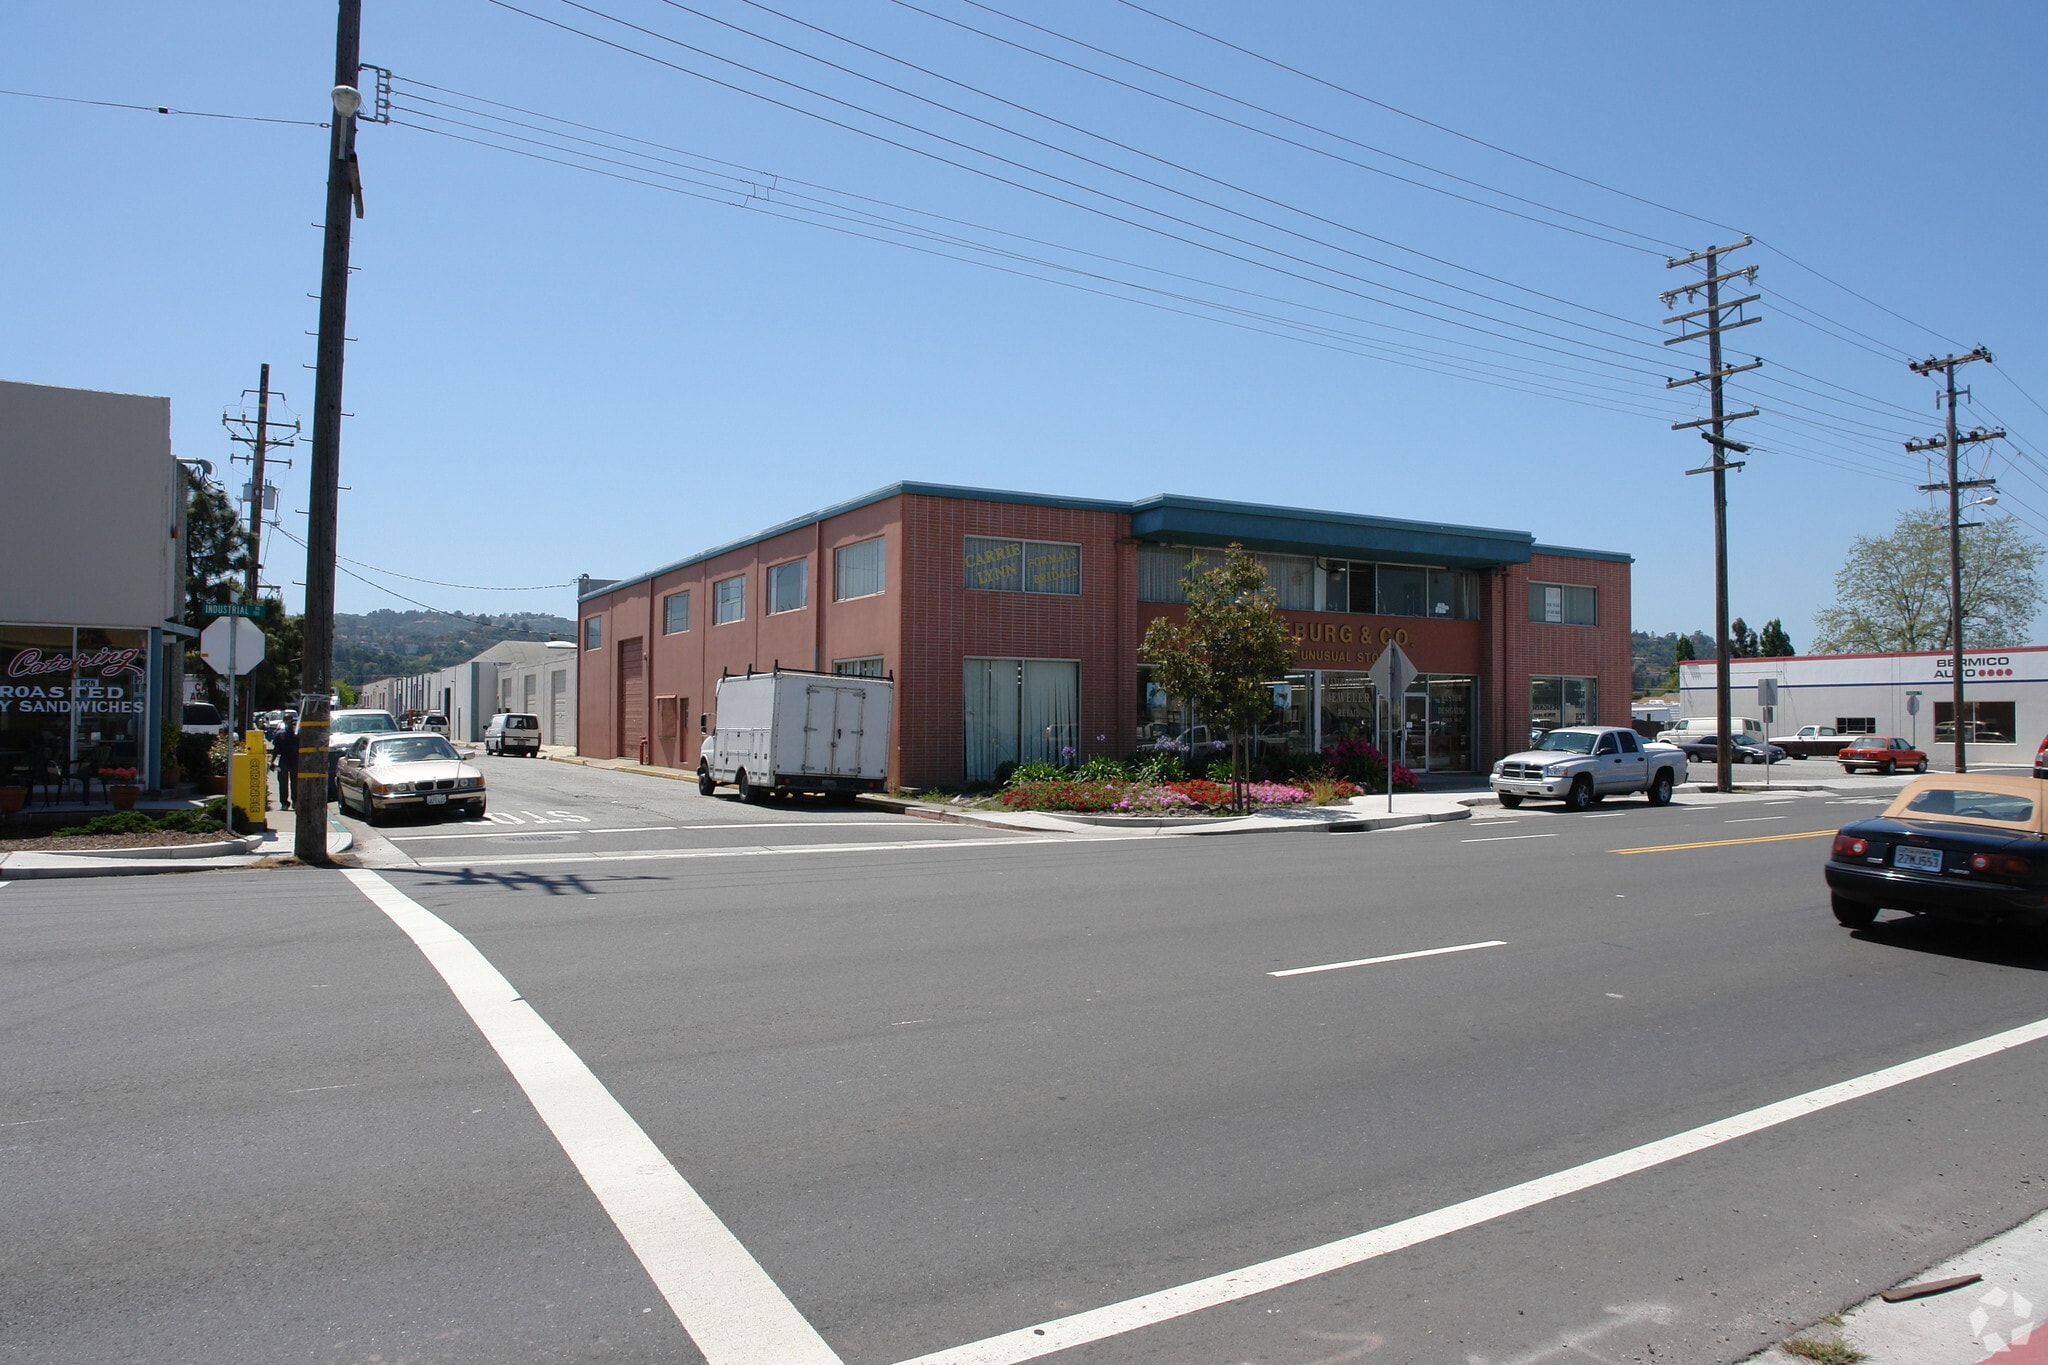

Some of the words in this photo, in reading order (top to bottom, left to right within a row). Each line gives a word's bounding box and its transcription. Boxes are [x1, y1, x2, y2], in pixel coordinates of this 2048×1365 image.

[965, 543, 1021, 567] CARRIE
[977, 563, 1017, 585] LYNN
[205, 604, 249, 615] INDUSTRIAL
[1360, 626, 1372, 644] &
[1379, 627, 1415, 648] CO.
[8, 647, 145, 677] Catering
[1301, 650, 1350, 662] UNUSUAL
[1934, 668, 1976, 678] AUO
[0, 685, 123, 699] ROASTED
[19, 700, 144, 714] SANDWICHES
[250, 758, 260, 813] CHRONICLE
